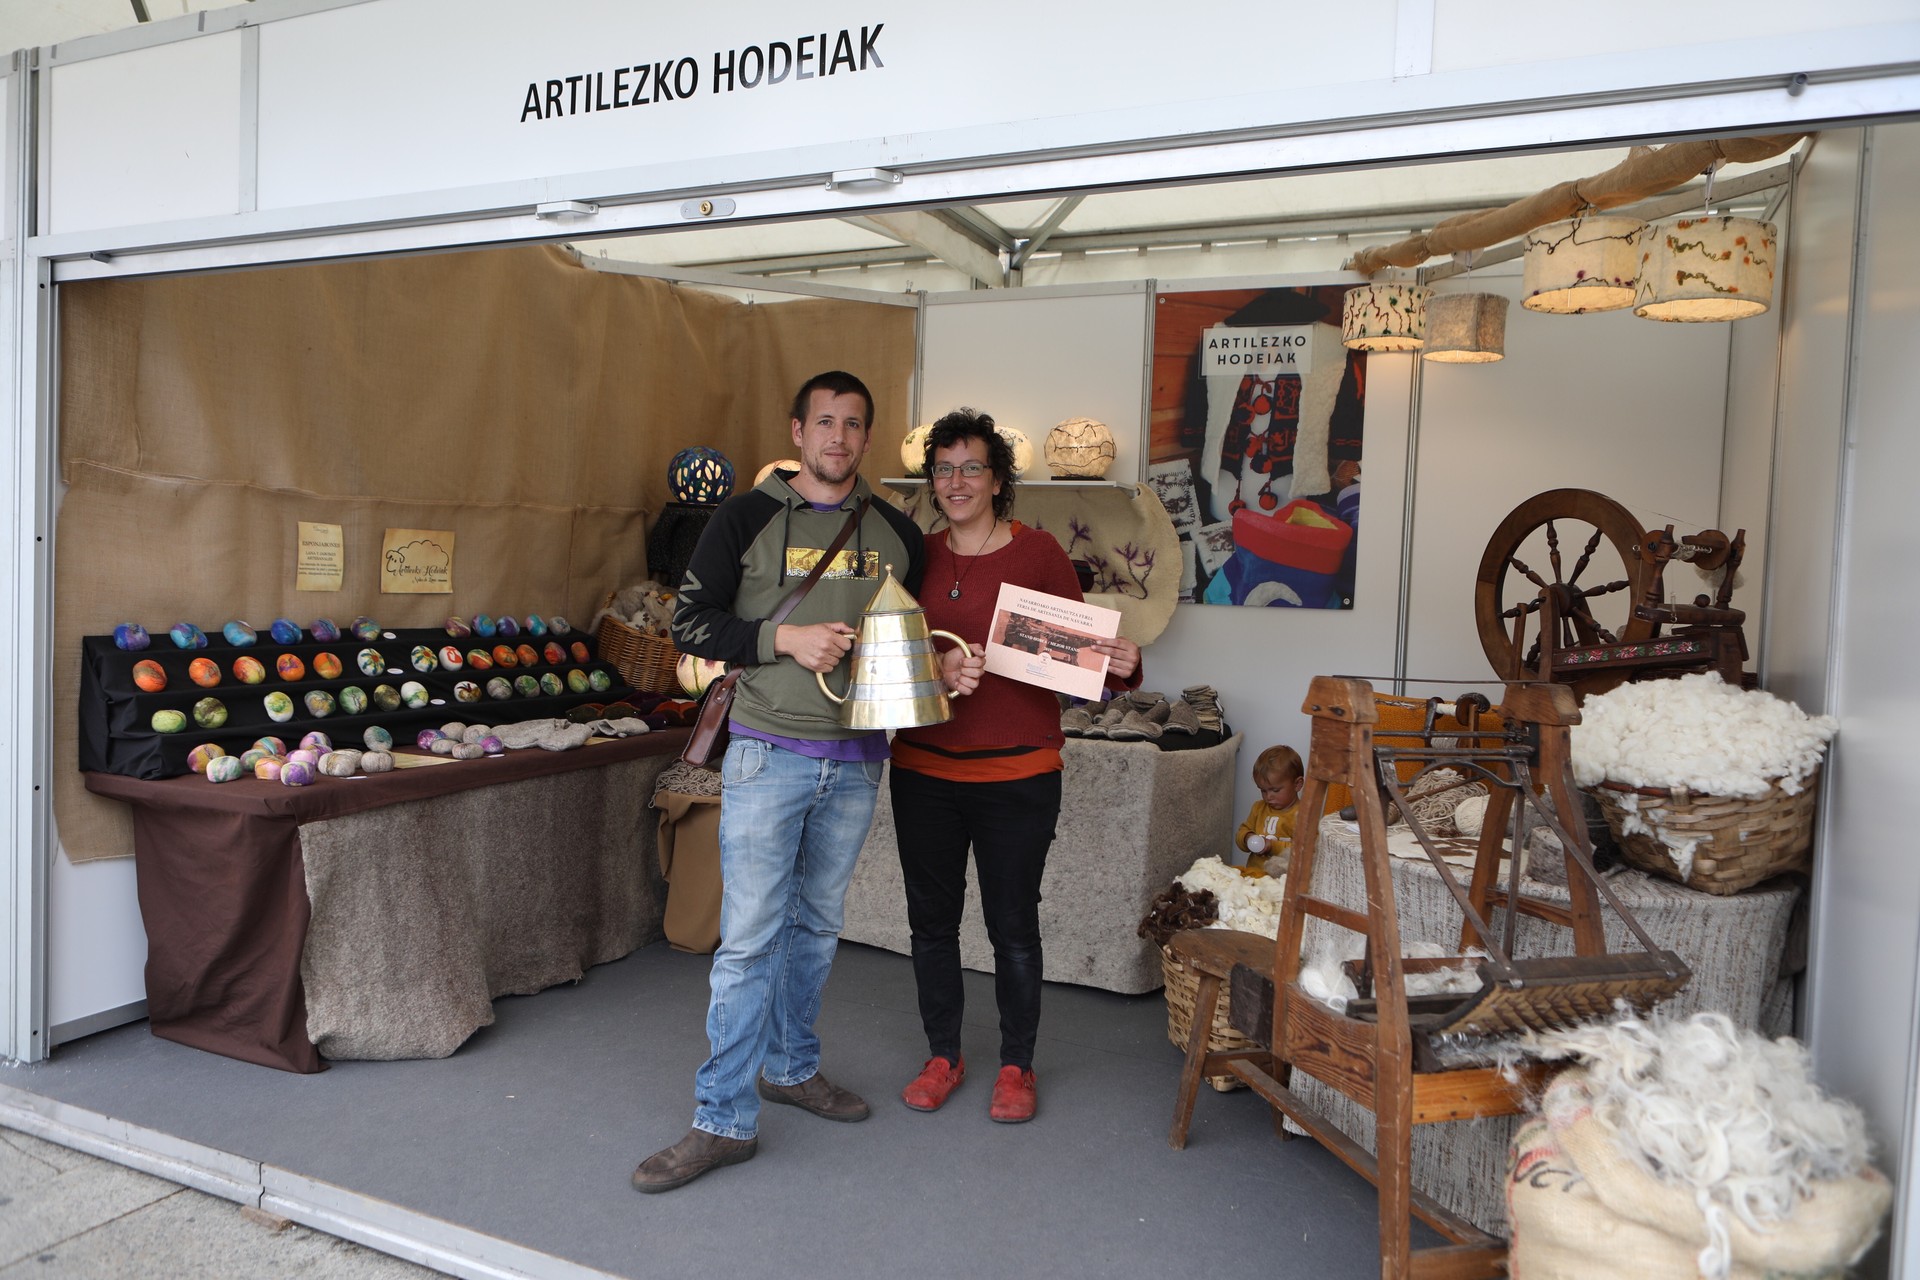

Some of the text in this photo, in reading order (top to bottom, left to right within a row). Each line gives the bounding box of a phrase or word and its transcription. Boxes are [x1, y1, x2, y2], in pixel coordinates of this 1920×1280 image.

[520, 23, 884, 122] ARTILEZKO HODEIAK
[1208, 335, 1306, 349] ARTILEZKO
[1217, 352, 1296, 365] HODEIAK
[1070, 618, 1093, 627] NAVARRA
